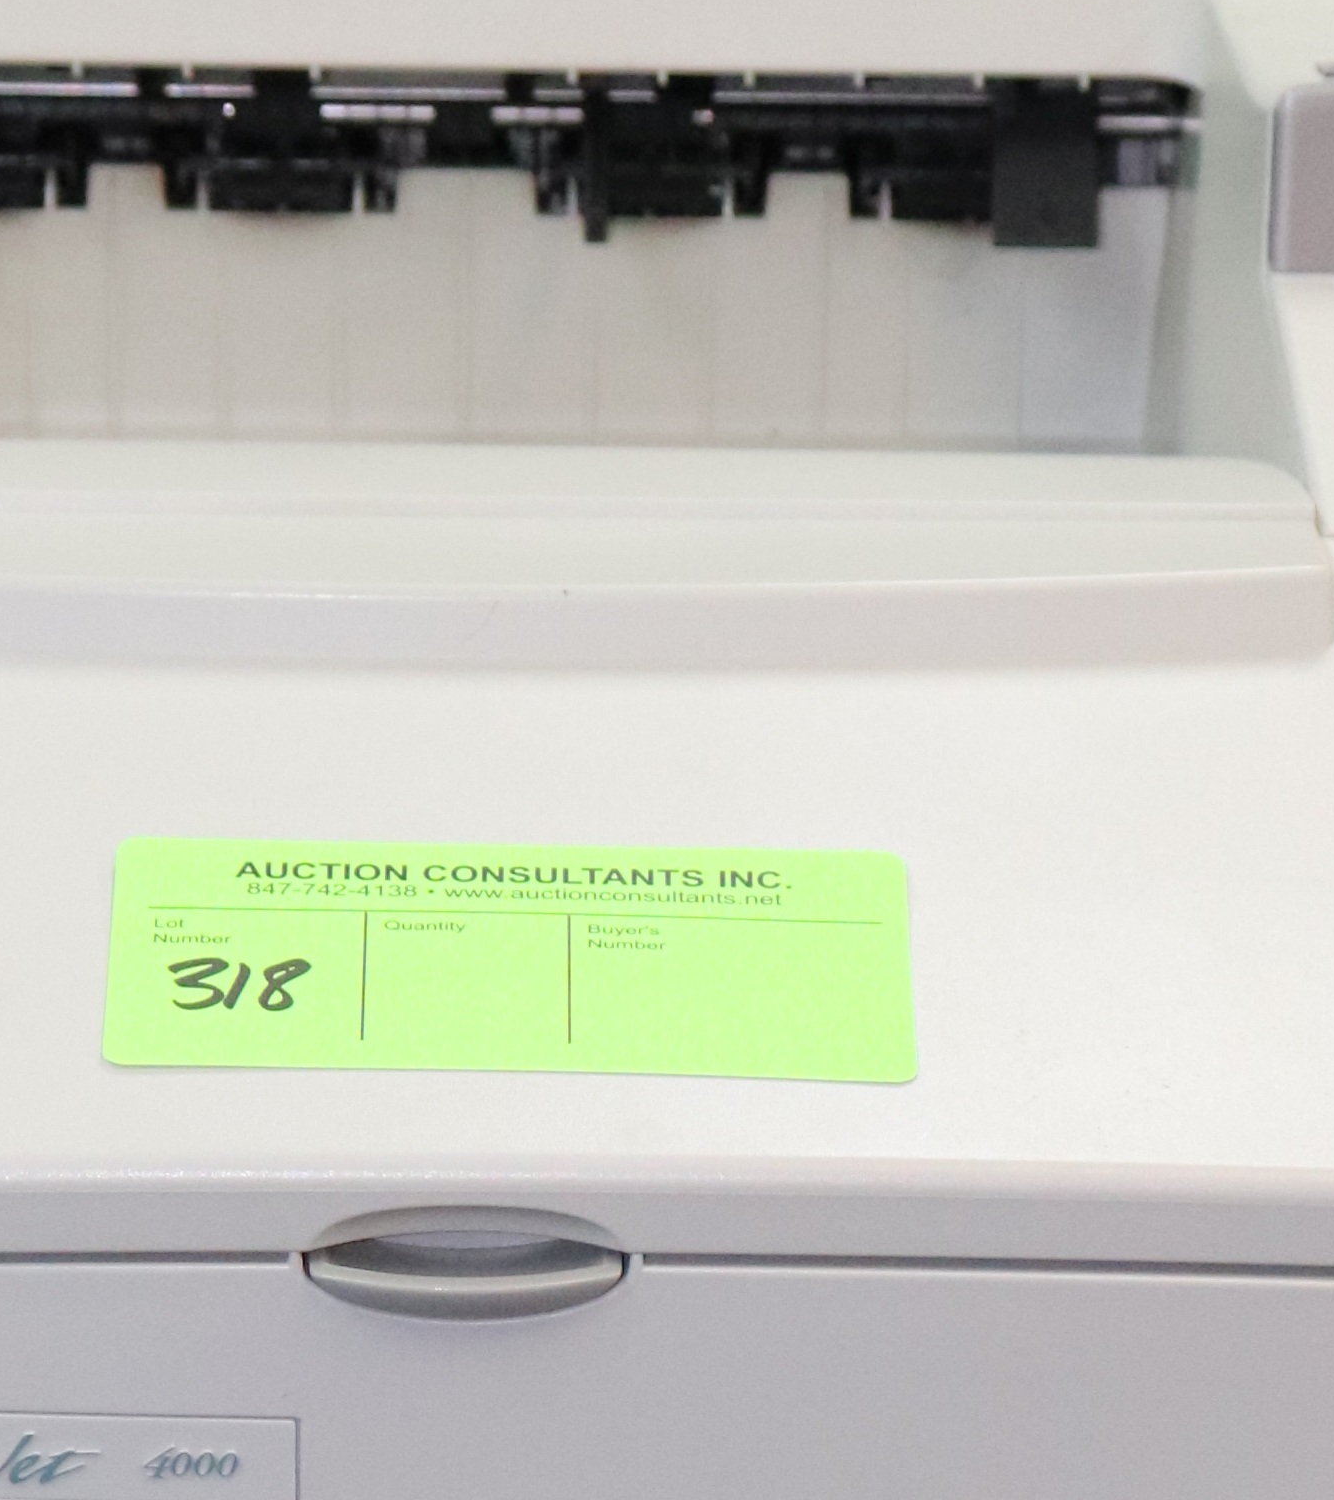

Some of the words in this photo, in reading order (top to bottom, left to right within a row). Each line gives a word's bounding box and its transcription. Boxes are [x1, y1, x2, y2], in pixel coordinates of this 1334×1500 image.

[235, 860, 408, 882] AUCTION
[423, 864, 704, 888] CONSULTANTS
[718, 869, 793, 890] INC.
[246, 881, 417, 898] 847-742-4138
[444, 886, 783, 907] www.auctionconsultants.net
[154, 917, 185, 929] Lot
[384, 919, 467, 934] Quantity
[587, 923, 661, 938] Buyer's
[152, 932, 232, 945] Number
[587, 938, 667, 951] Number
[167, 957, 313, 1012] 318
[141, 1443, 240, 1480] 4000
